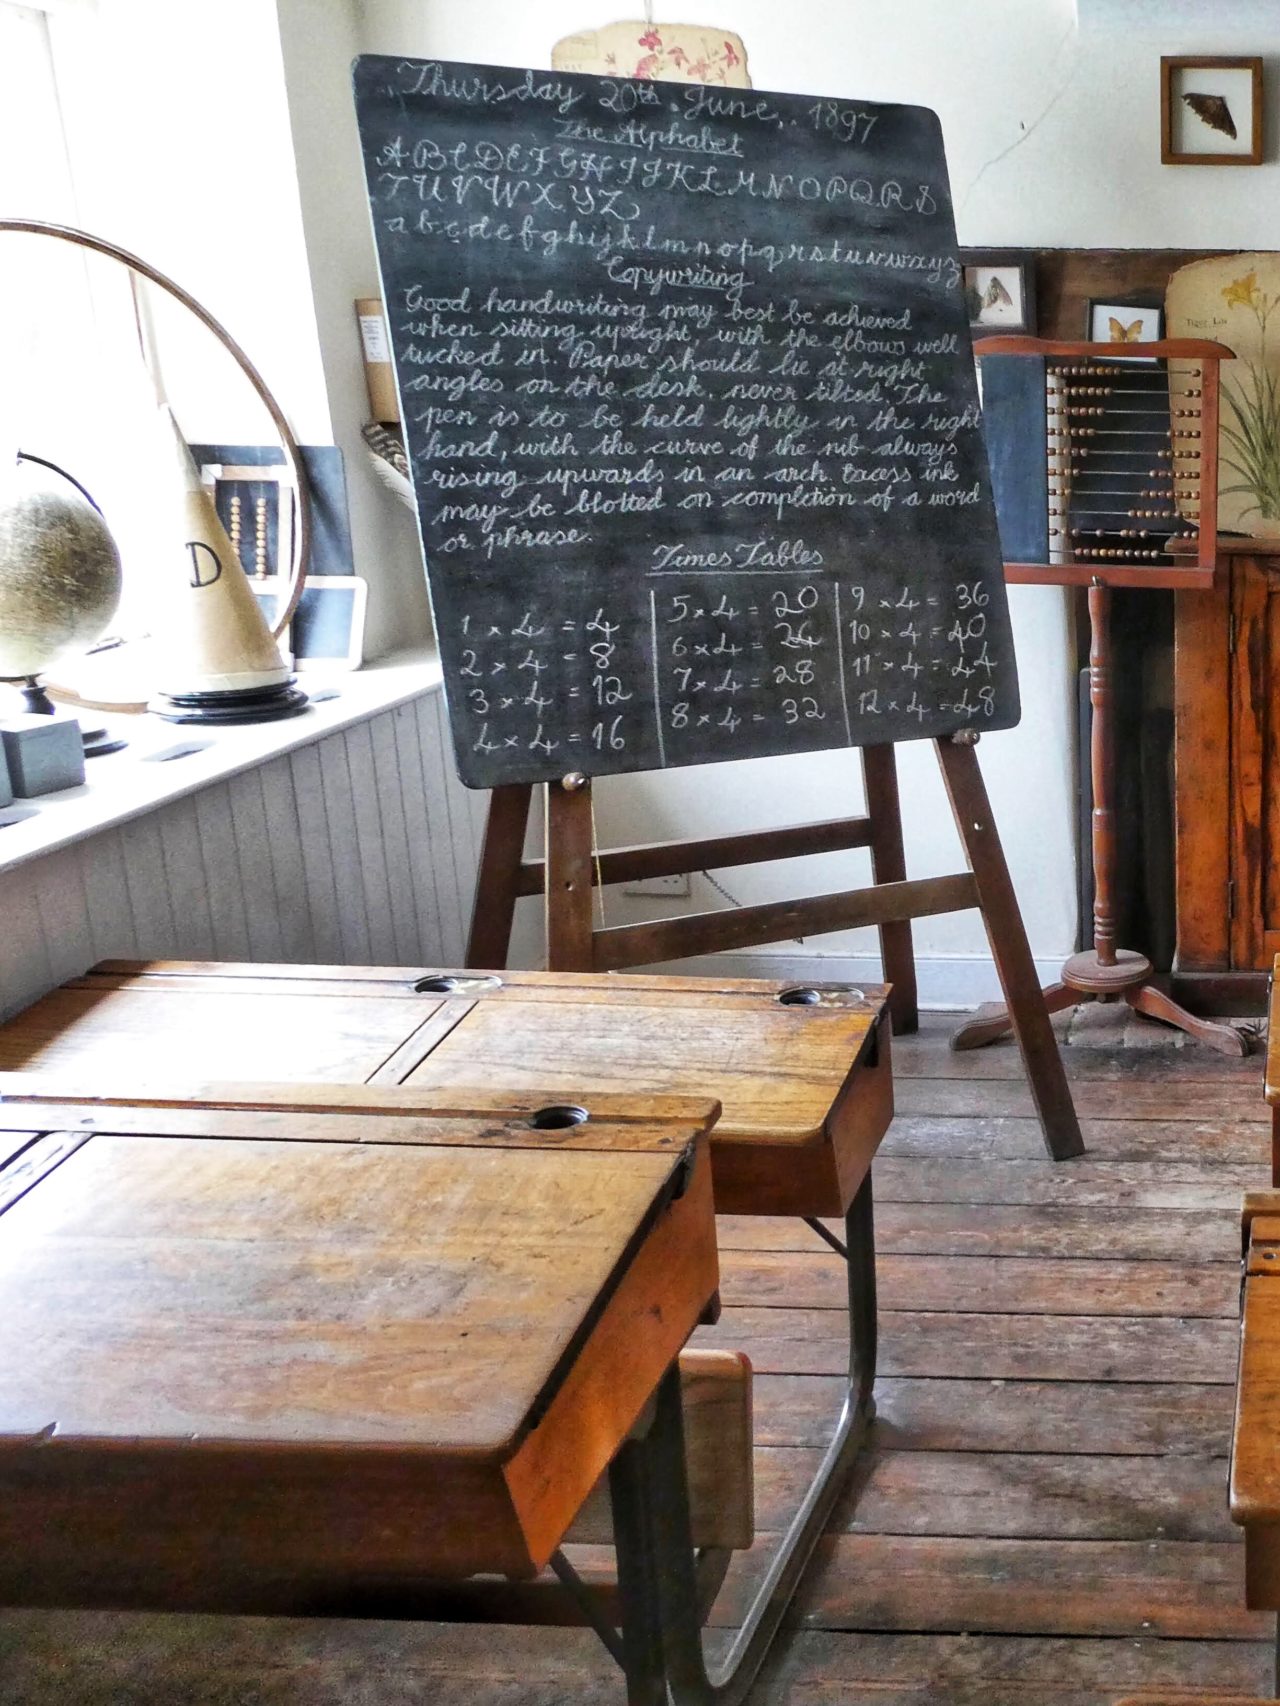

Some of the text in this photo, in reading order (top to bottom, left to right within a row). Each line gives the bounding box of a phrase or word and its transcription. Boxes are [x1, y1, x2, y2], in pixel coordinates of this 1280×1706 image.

[398, 61, 583, 113] Thursday
[809, 102, 879, 143] 1897
[553, 118, 743, 155] The Alphabet
[603, 256, 755, 300] Copywriting
[404, 285, 912, 330] Good handwriting may best be achieved
[400, 313, 480, 338] when
[490, 318, 585, 350] sitting
[708, 324, 771, 345] with
[780, 328, 822, 347] the
[827, 329, 905, 355] elbows
[914, 334, 959, 354] well
[402, 340, 503, 365] tucked
[568, 340, 649, 376] Paper
[657, 346, 760, 372] should
[769, 350, 809, 375] lie
[818, 355, 848, 376] at
[854, 359, 925, 387] right
[405, 369, 504, 401] angles
[515, 379, 559, 394] on
[564, 375, 618, 397] the
[721, 383, 798, 400] never
[894, 383, 947, 404] The
[414, 404, 980, 441] pen is to be held lightly in the right
[417, 430, 958, 465] hand, with the curve of the nib always
[424, 464, 522, 498] rising
[534, 459, 664, 496] upwards
[674, 460, 704, 483] in
[715, 466, 755, 481] an
[920, 461, 959, 481] ink
[431, 482, 980, 533] may be blotted on completion of a word
[185, 541, 222, 588] D
[651, 539, 823, 570] Times Tables
[667, 586, 818, 623] 5 4 20
[851, 581, 990, 611] 9 4 36
[462, 608, 620, 641] 1 4 4
[672, 622, 823, 657] 6 4 24
[849, 612, 986, 654] 10 4 40
[460, 643, 616, 677] 2 4 8
[673, 660, 816, 696] 7 4 28
[852, 641, 998, 680] 11 4 44
[469, 675, 632, 717] 3 4 12
[859, 686, 995, 722] 12 4 48
[671, 697, 826, 733] 8 4 32
[473, 715, 626, 755] 4 4 16
